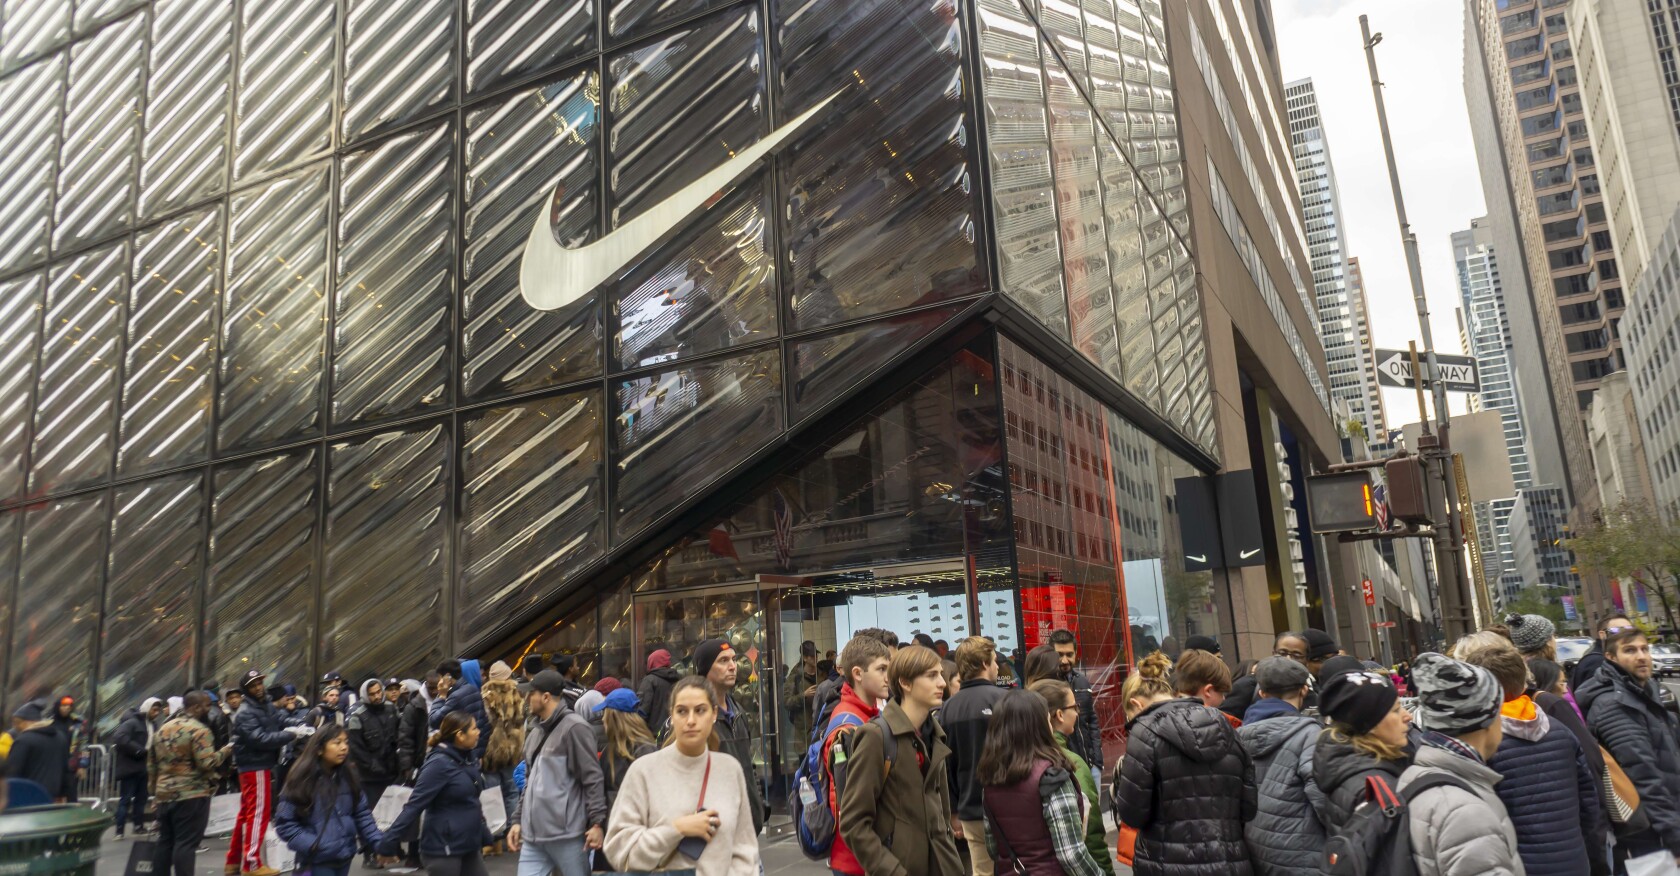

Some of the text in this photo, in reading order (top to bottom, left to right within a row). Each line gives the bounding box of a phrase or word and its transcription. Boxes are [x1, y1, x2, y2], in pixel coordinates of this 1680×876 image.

[1390, 362, 1469, 381] ON WAY
[836, 446, 931, 506] INNOVATION
